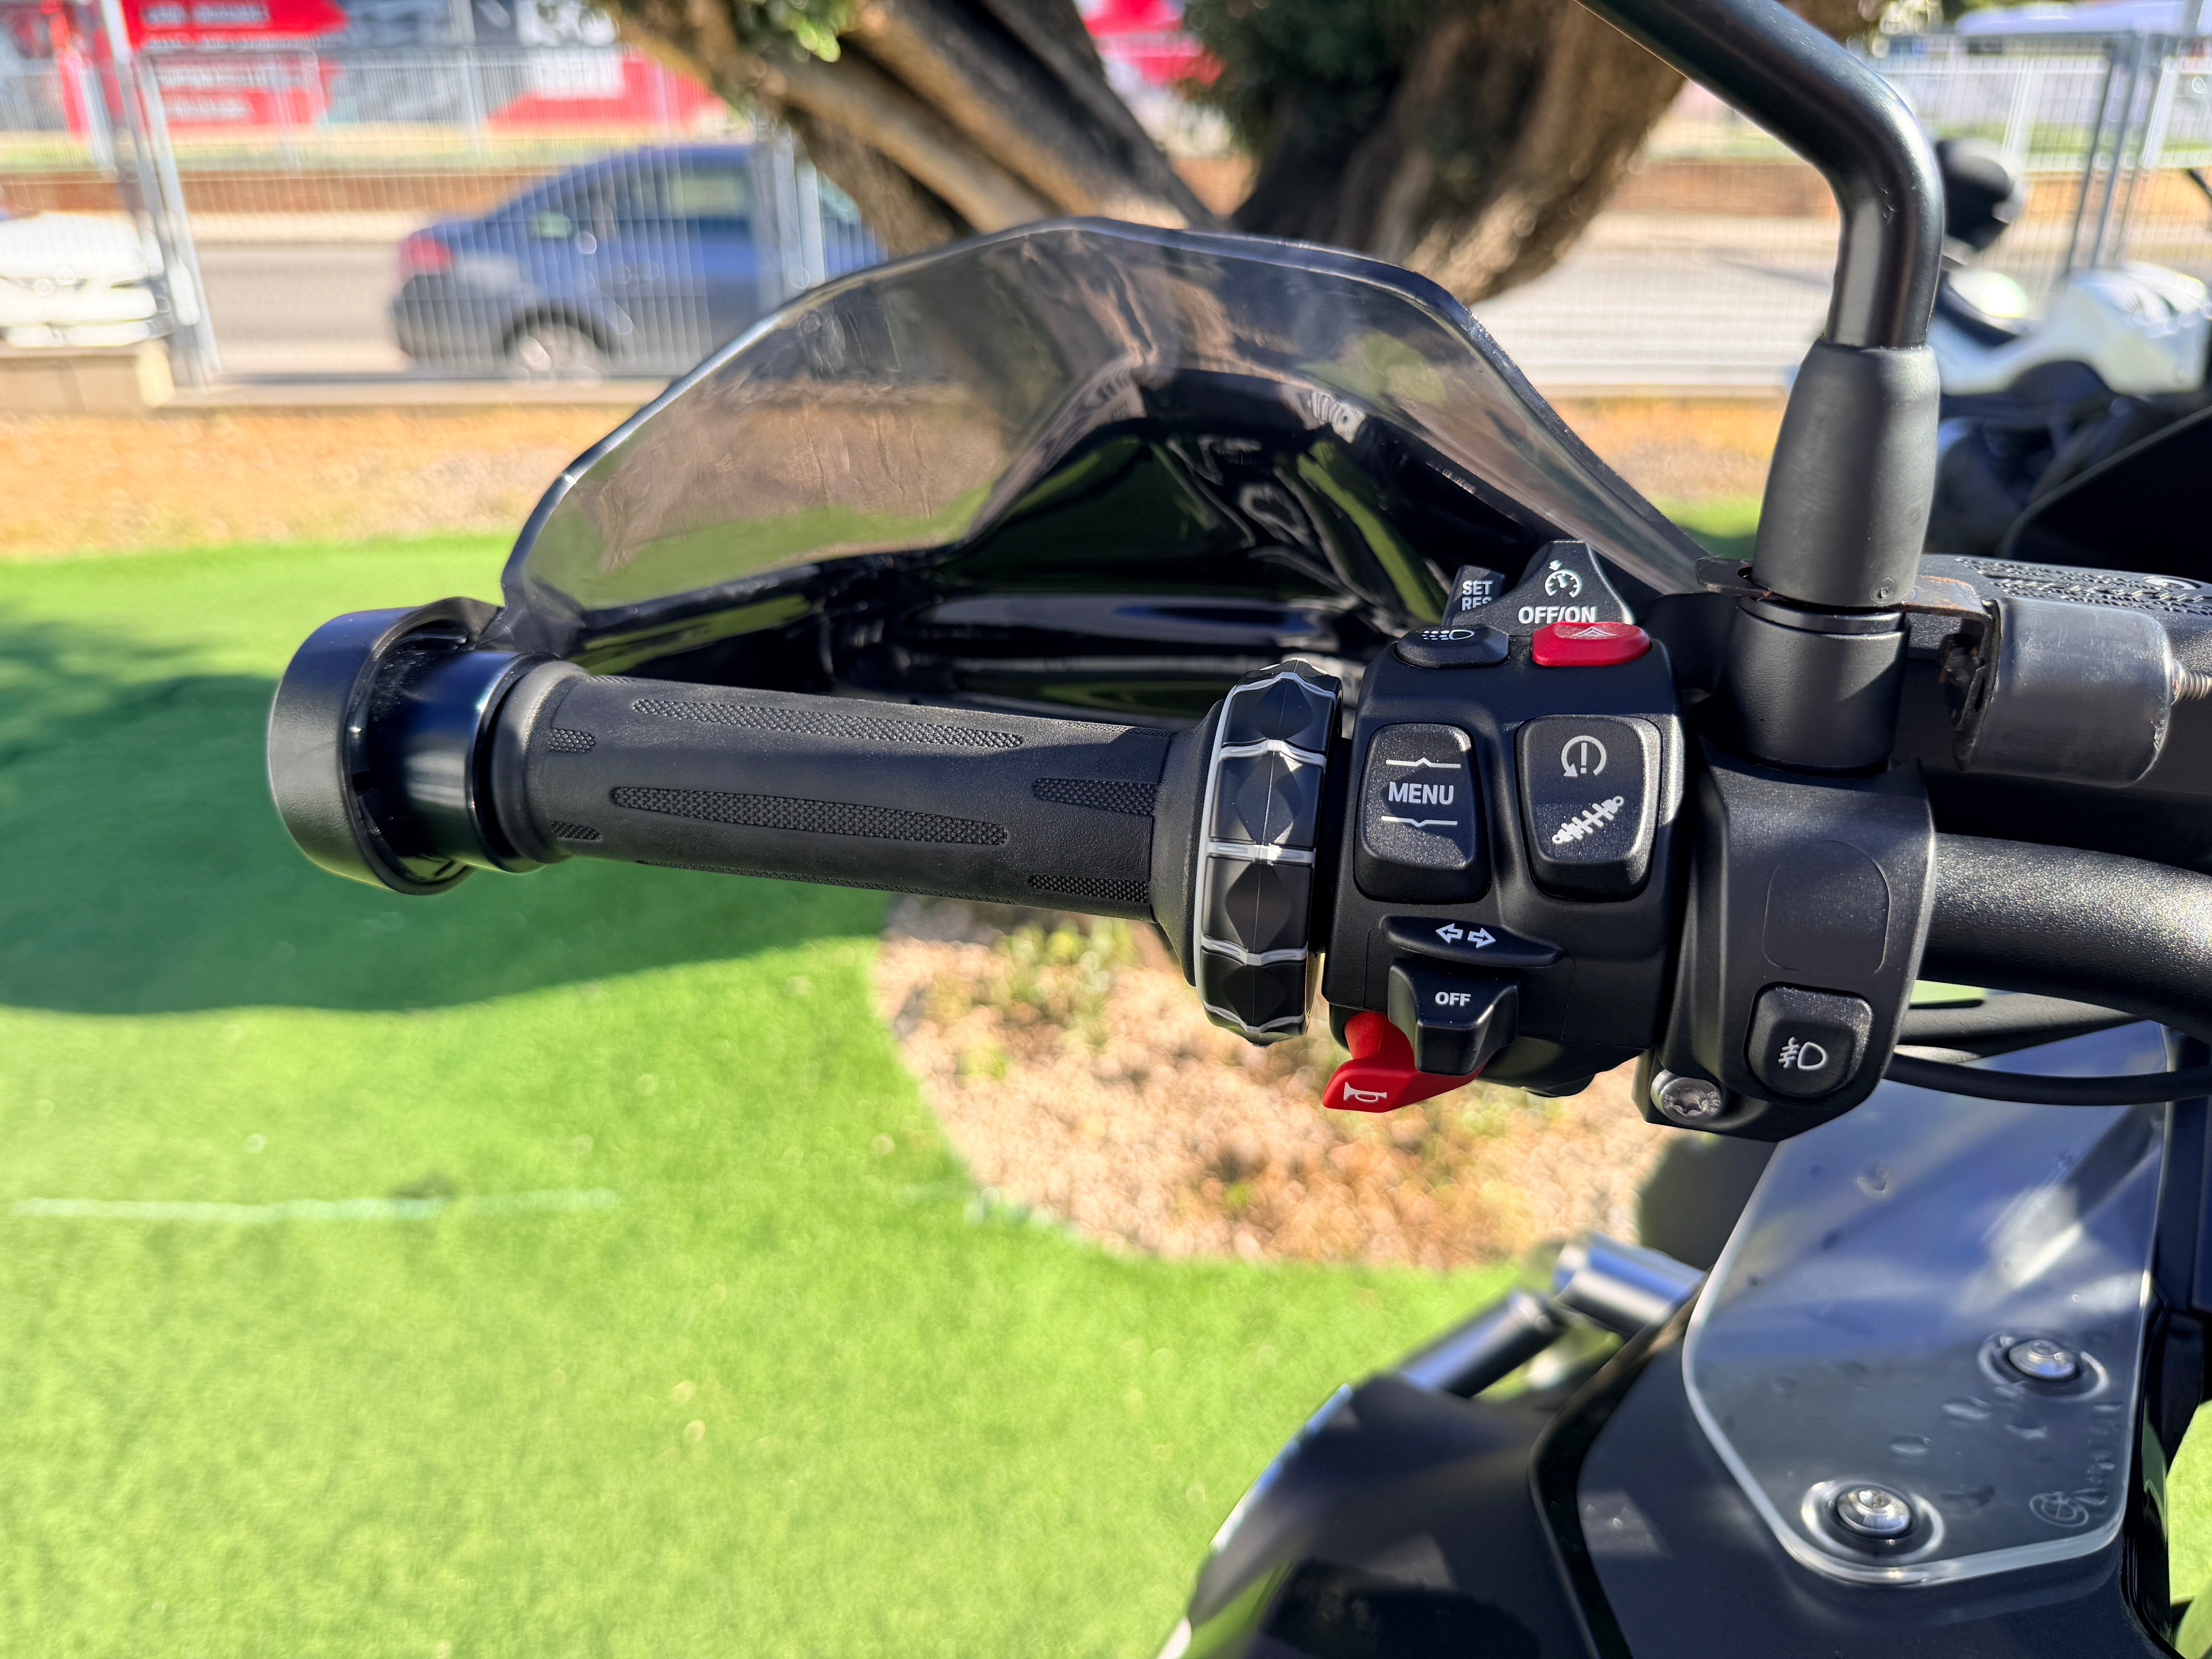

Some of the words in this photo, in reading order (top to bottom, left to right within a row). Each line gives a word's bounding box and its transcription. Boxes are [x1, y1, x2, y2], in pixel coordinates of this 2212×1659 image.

[1462, 580, 1493, 595] SET
[1518, 606, 1597, 624] OFF/ON
[1388, 781, 1454, 805] MENU
[1435, 991, 1471, 1006] OFF
